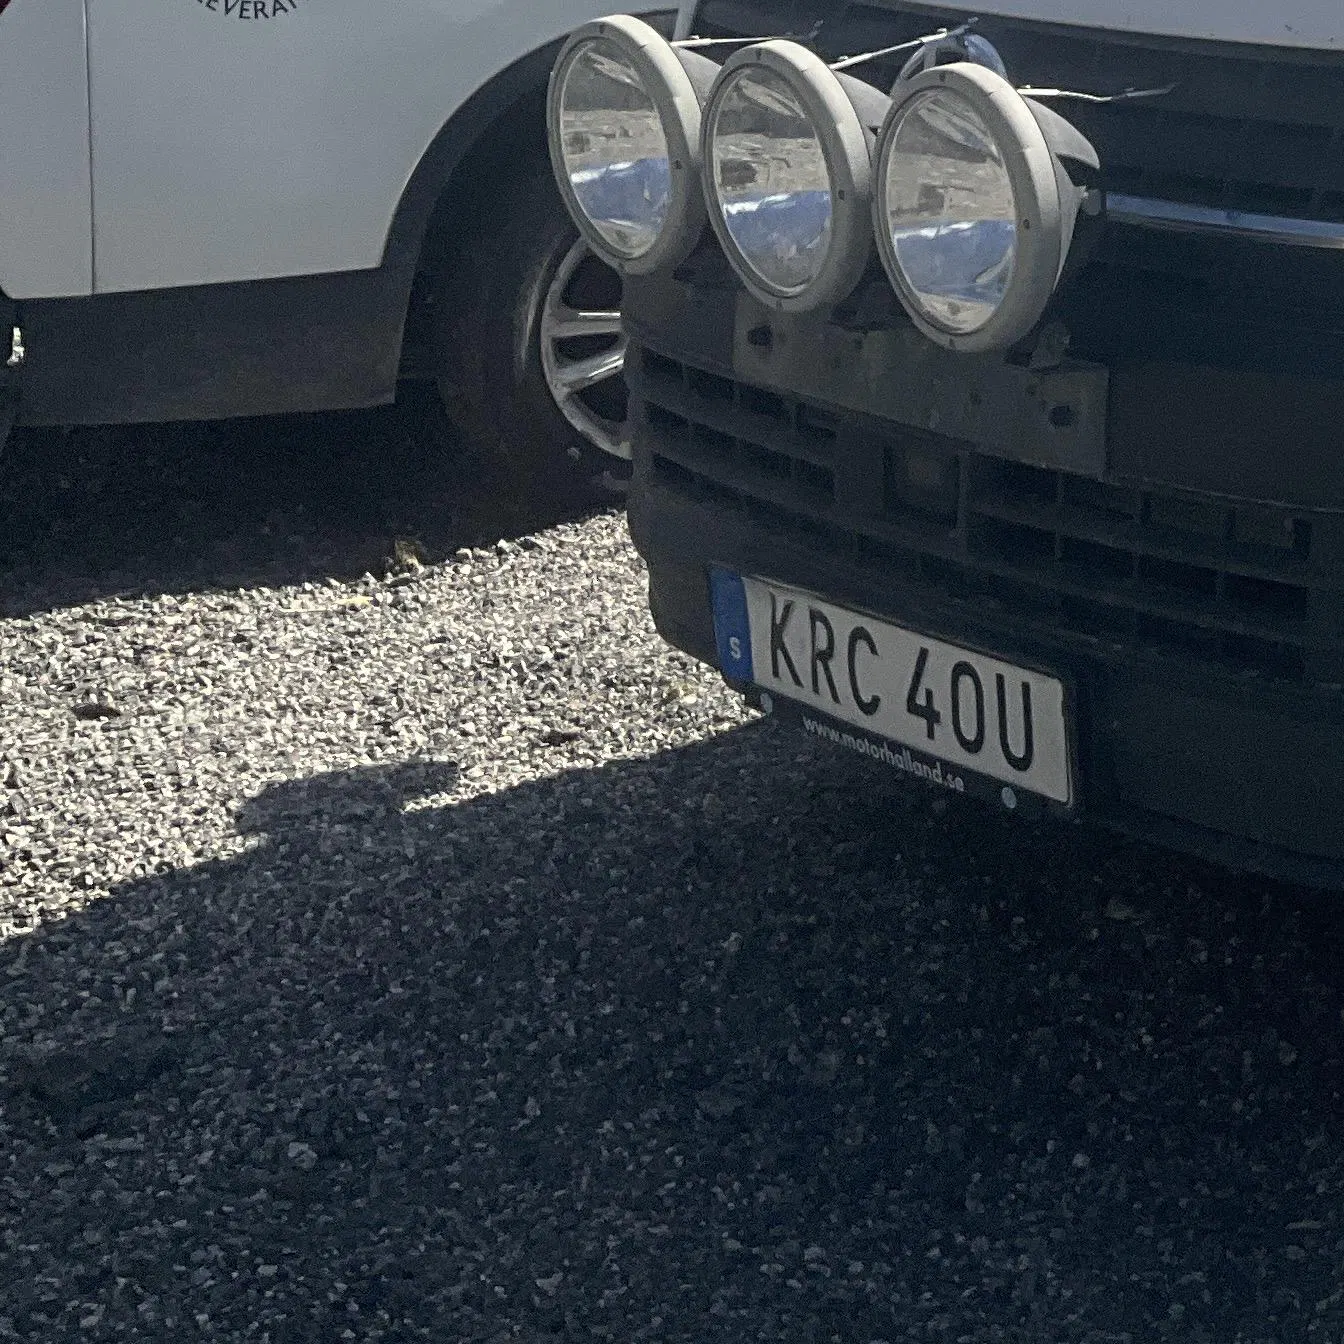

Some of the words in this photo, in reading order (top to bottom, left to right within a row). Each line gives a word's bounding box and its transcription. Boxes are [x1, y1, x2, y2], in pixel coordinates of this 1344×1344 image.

[729, 636, 741, 659] S
[769, 591, 881, 716] KRC
[906, 646, 1034, 771] 40U
[802, 716, 965, 792] www.motorhalland.se
